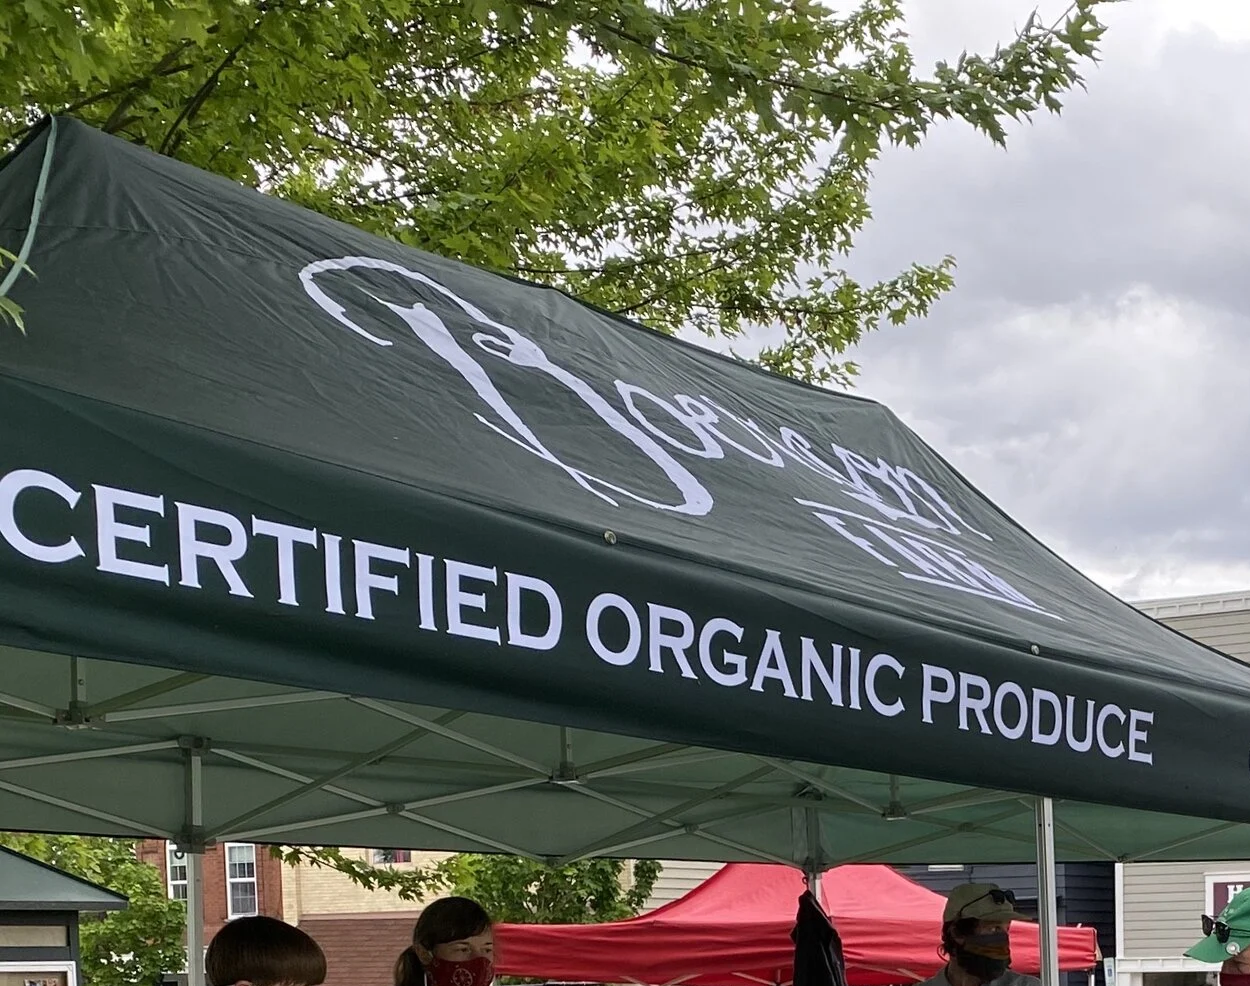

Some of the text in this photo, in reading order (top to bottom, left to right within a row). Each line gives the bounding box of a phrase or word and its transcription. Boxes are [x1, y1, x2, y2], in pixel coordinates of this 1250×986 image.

[0, 469, 1155, 766] CERTIFIED ORGANIC PRODUCE
